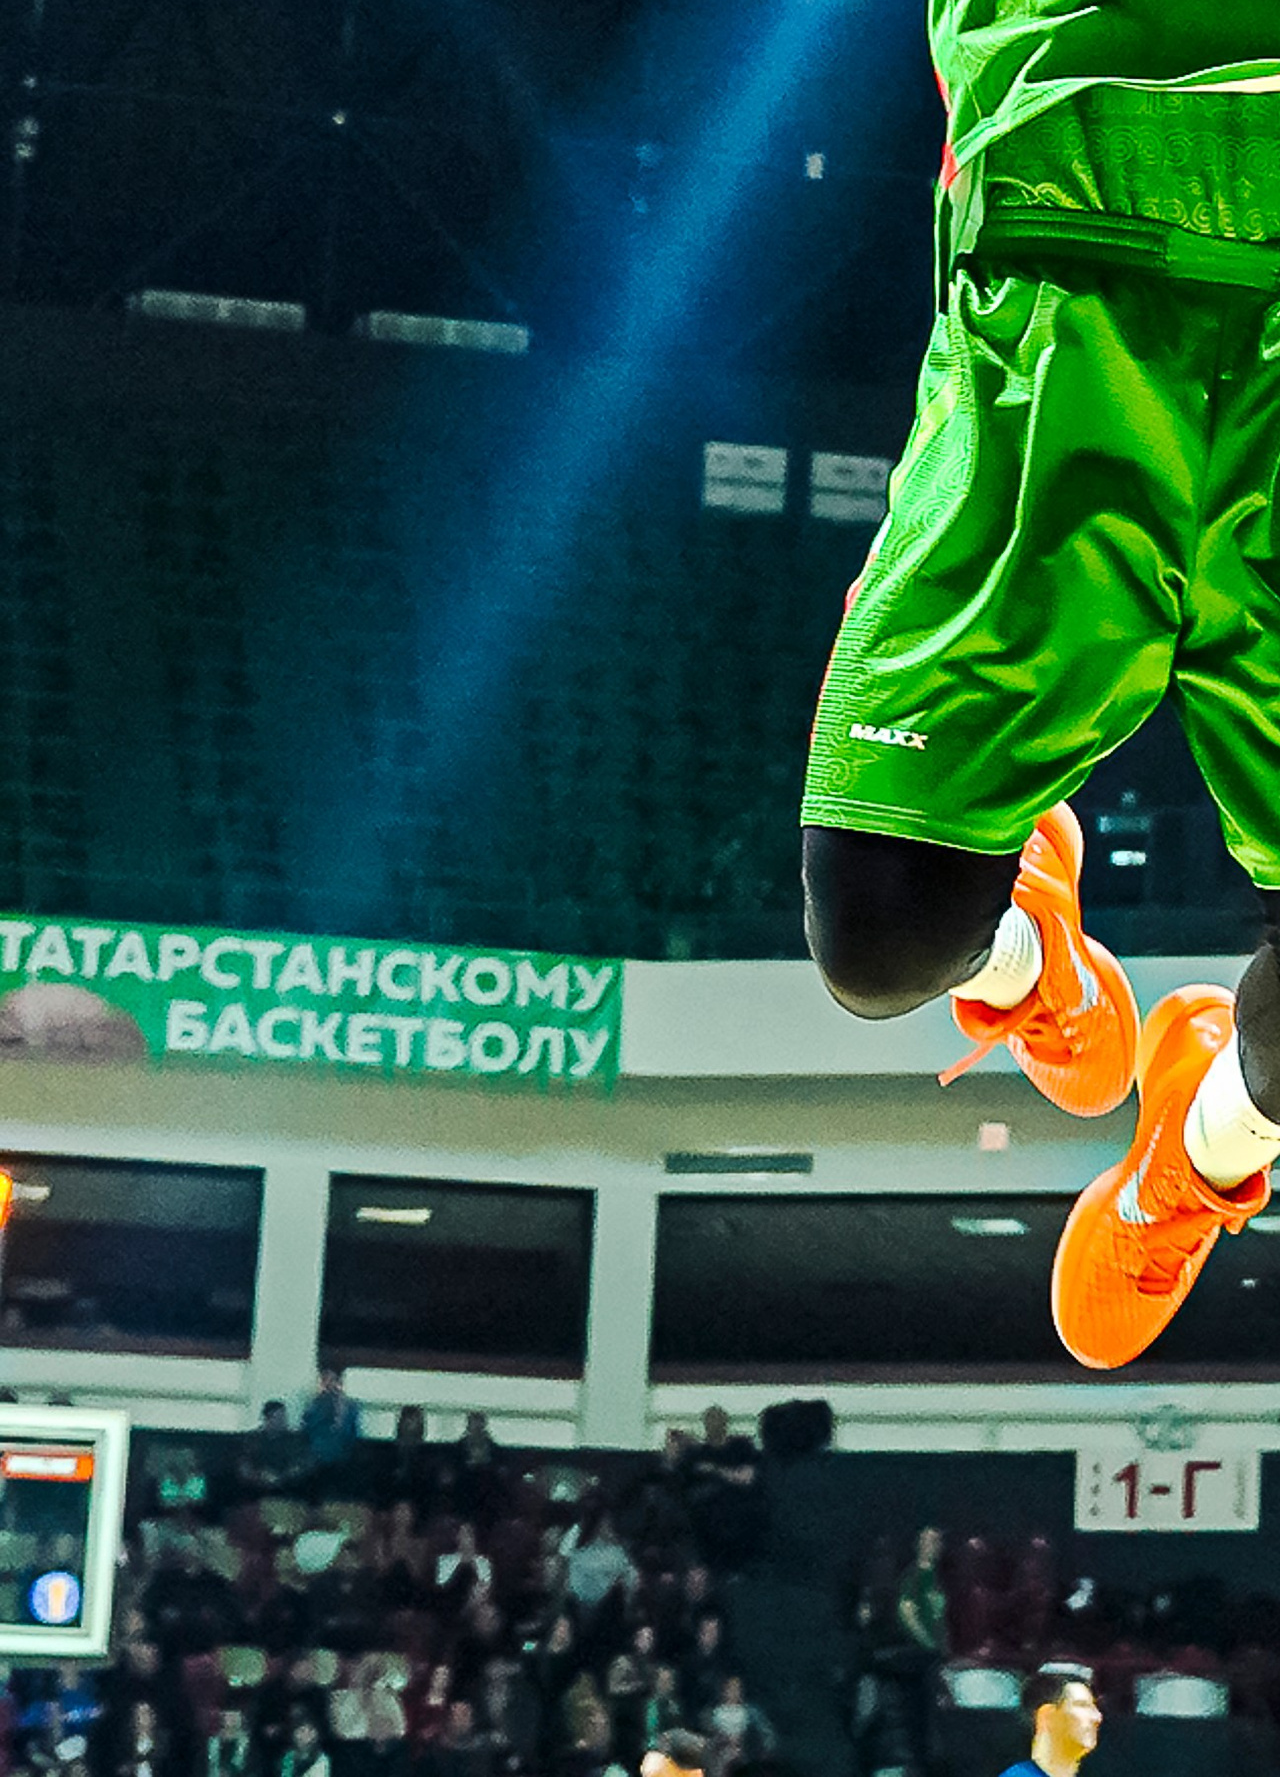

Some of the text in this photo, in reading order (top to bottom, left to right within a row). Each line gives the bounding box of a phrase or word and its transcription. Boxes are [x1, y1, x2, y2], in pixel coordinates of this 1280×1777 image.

[849, 723, 928, 751] MAXX
[0, 920, 613, 1012] ТАТАРСТАНСКОМУ
[166, 998, 610, 1076] БАСКЕТБОЛУ
